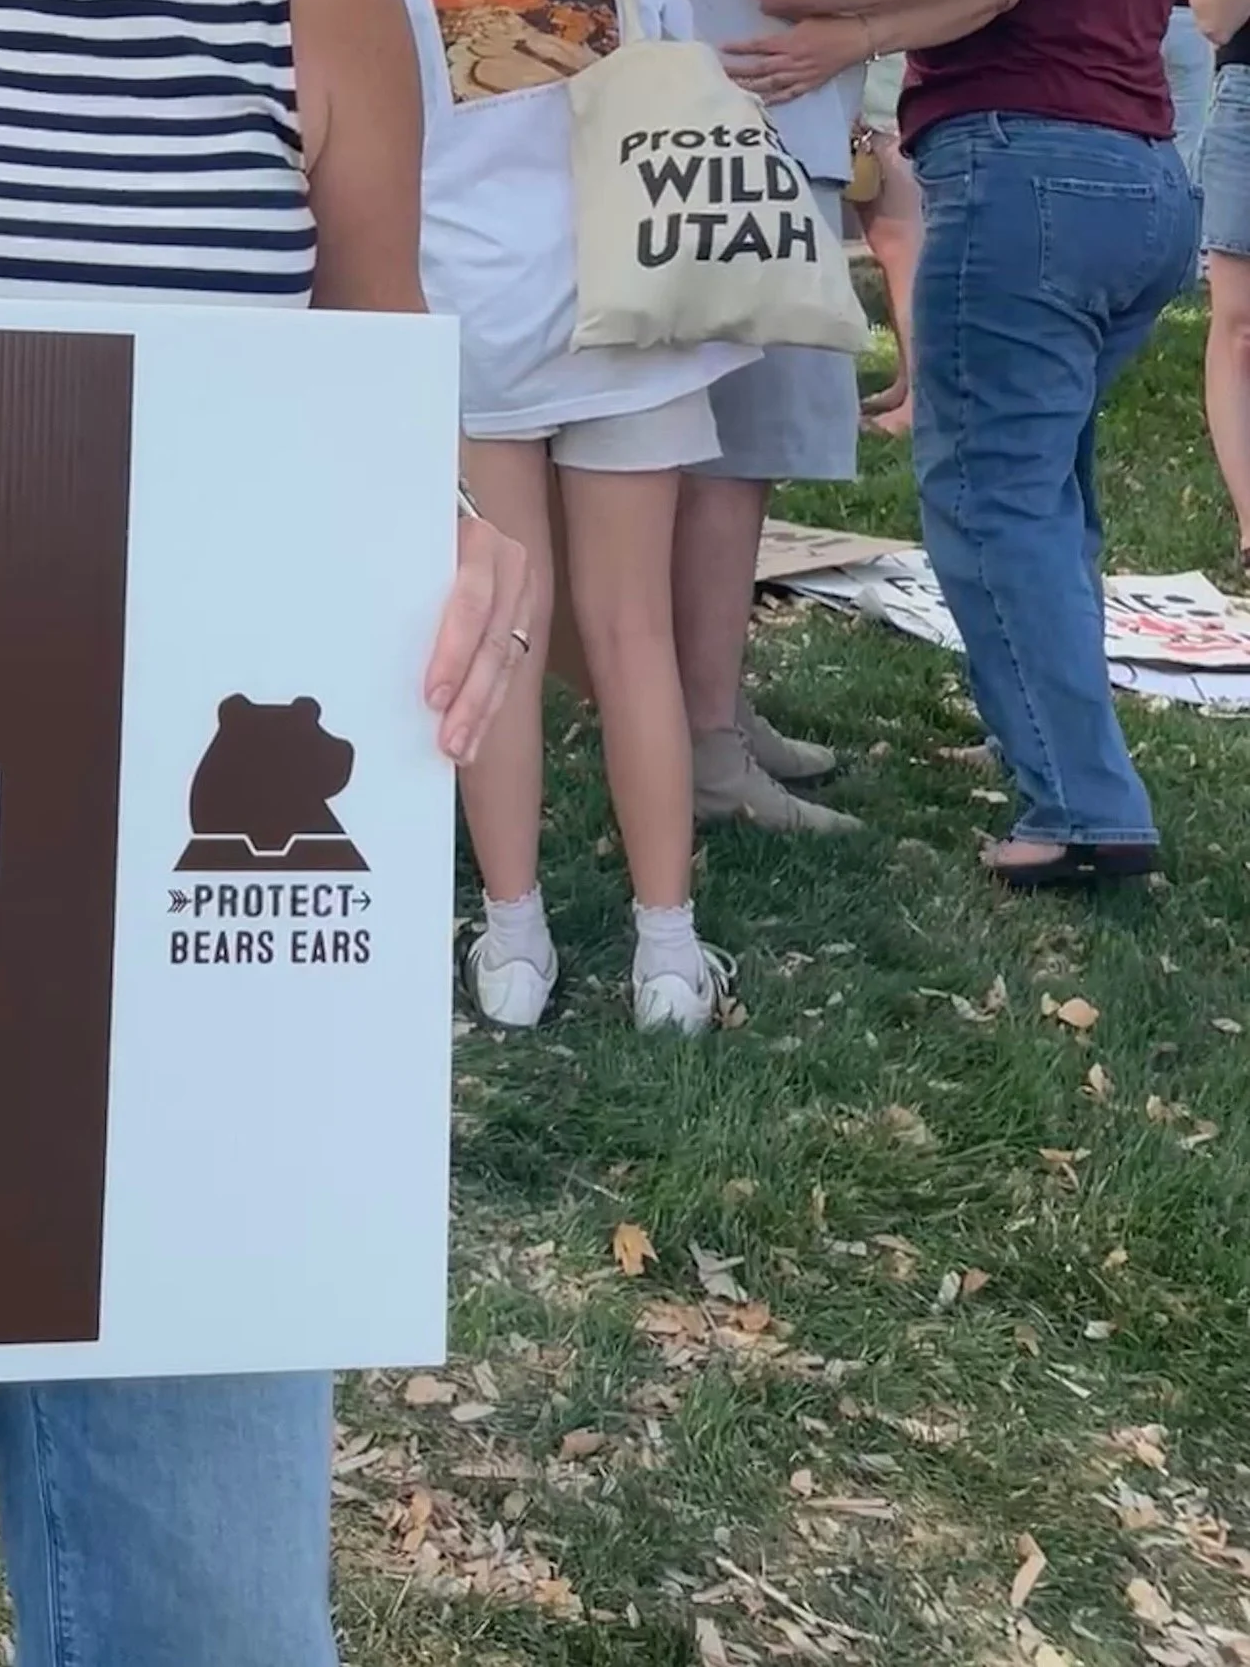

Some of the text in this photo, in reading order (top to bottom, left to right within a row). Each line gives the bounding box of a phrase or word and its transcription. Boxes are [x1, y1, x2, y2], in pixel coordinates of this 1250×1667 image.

[638, 154, 799, 209] WILD
[637, 211, 817, 268] UTAH
[195, 885, 354, 917] PROTECT
[171, 930, 369, 963] BEARS EARS
